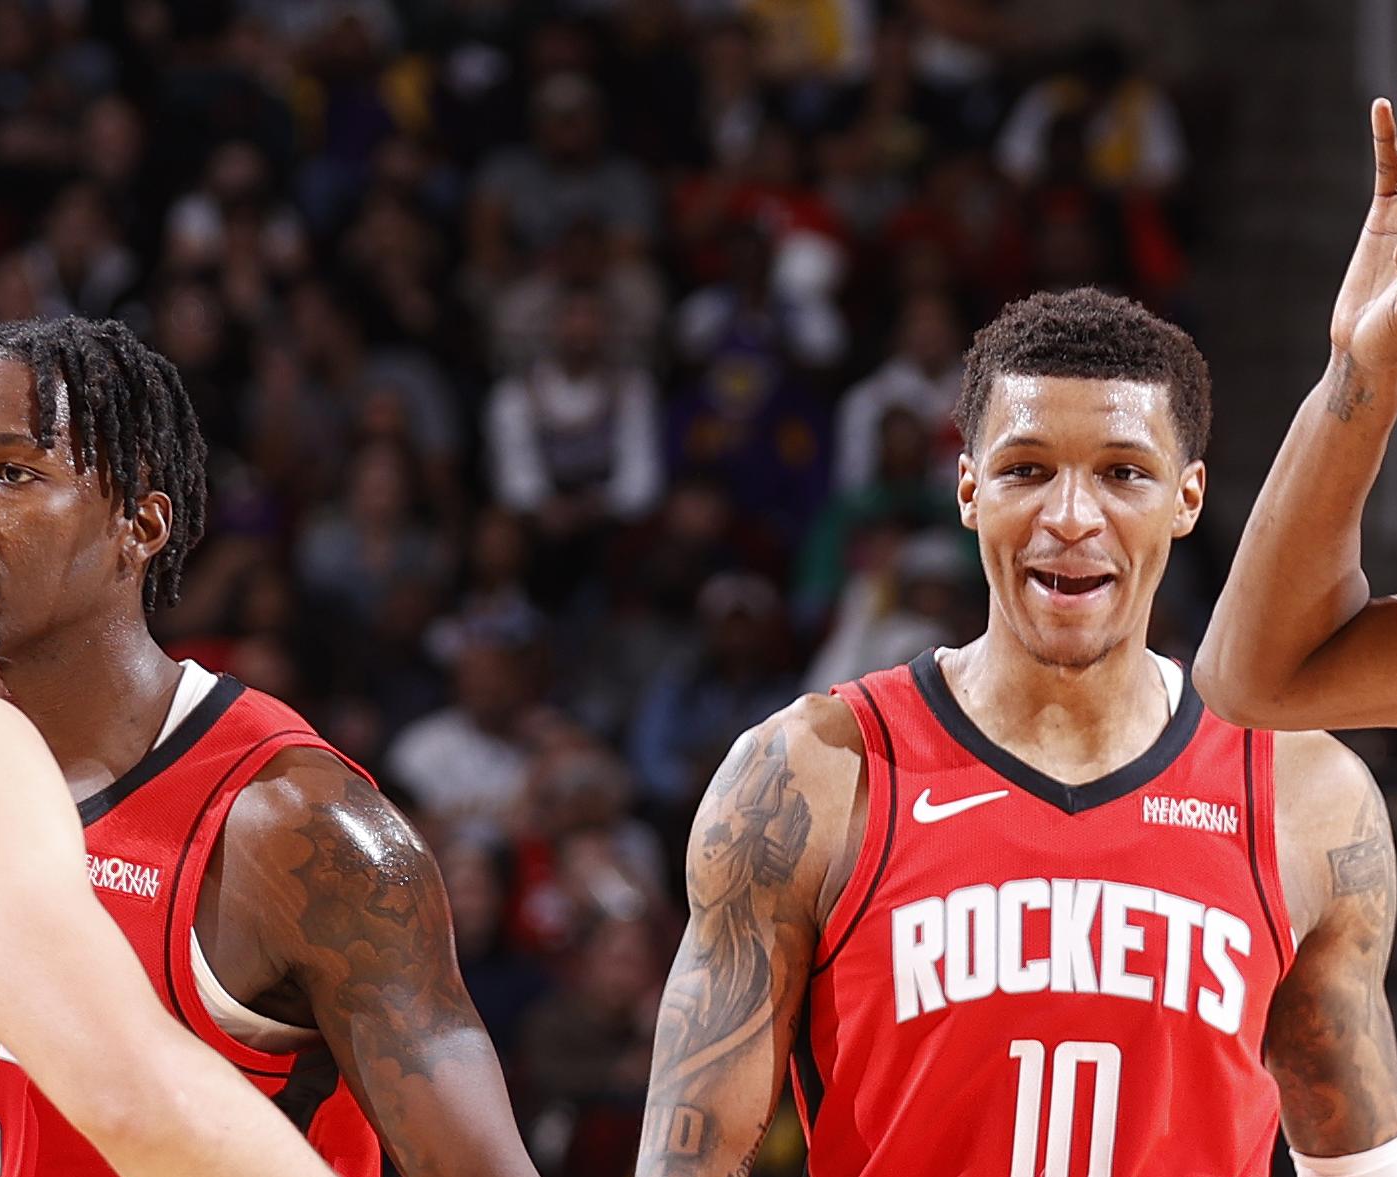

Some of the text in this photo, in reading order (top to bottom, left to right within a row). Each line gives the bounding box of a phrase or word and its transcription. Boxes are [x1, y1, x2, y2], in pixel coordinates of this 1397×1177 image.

[1143, 795, 1237, 822] MEMORIAL
[1143, 807, 1239, 834] HERMANN
[84, 854, 160, 884] EMORIAL
[86, 867, 160, 897] RMANN
[891, 877, 1252, 1035] ROCKETS
